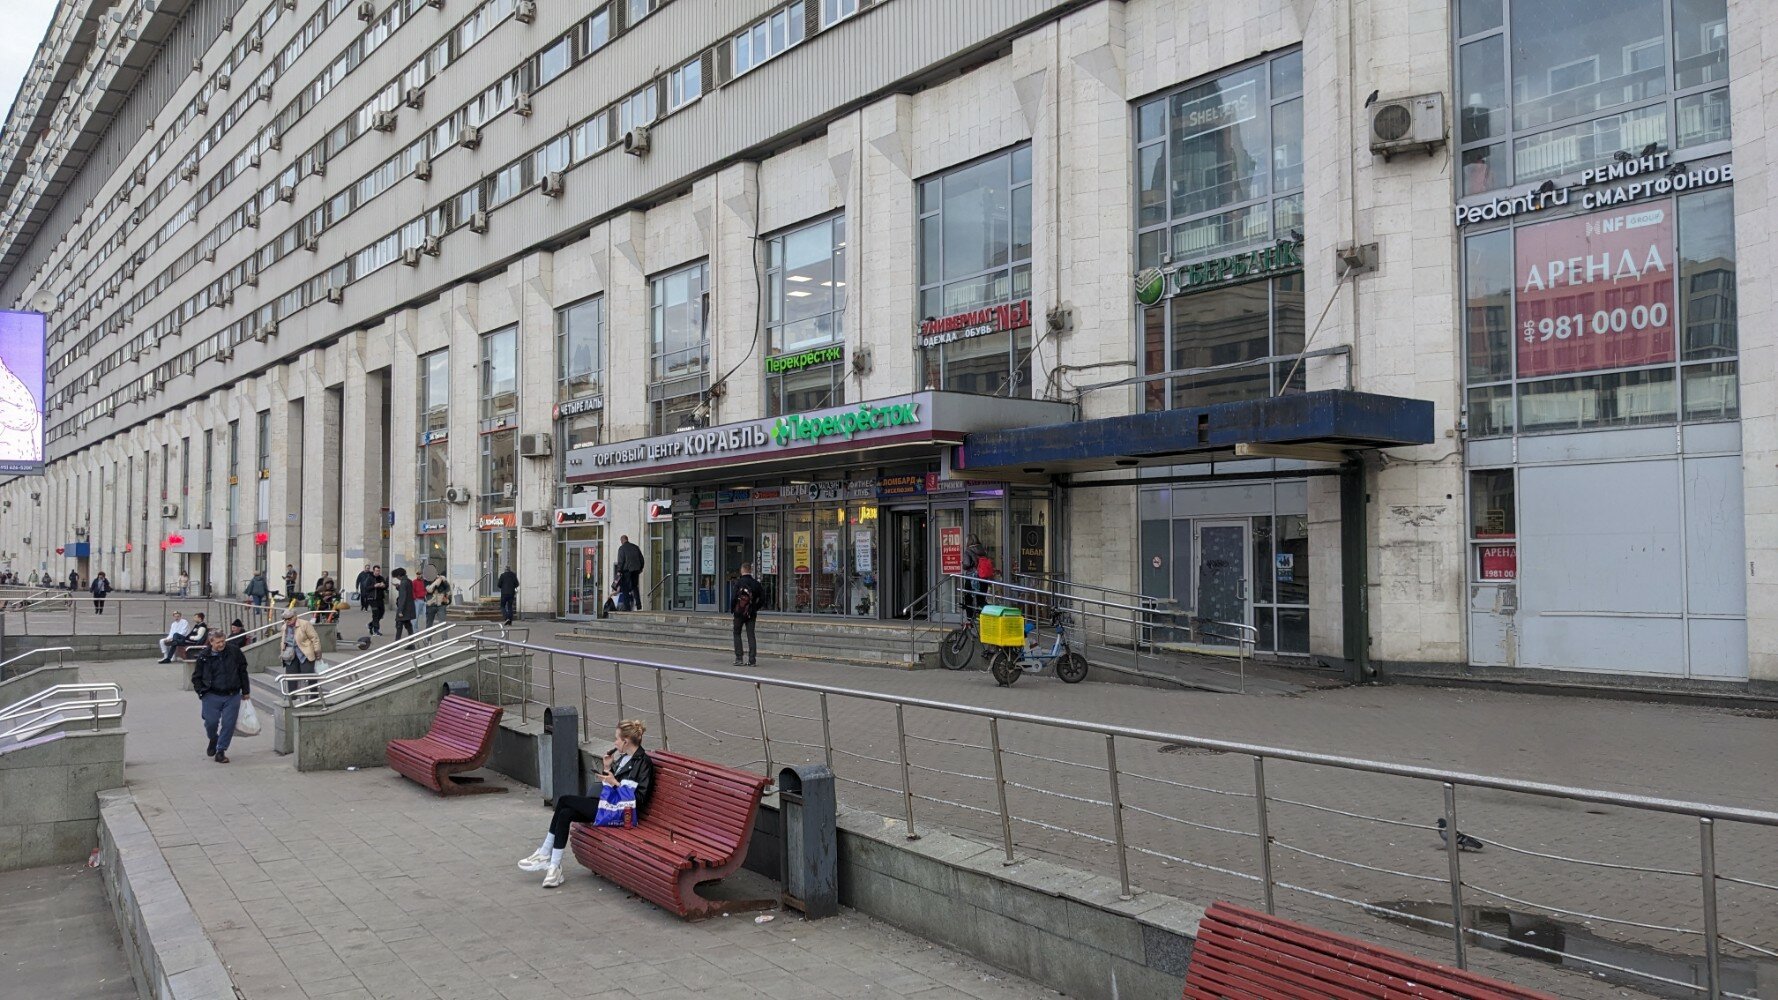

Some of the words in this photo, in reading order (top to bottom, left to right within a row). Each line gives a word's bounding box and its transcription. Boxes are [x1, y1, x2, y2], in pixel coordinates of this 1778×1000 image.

[1189, 94, 1249, 127] SHELTERS
[1581, 152, 1670, 186] РЕМОНТ
[1582, 164, 1734, 210] СМАРТФОНОВ
[1456, 186, 1570, 227] Pedant.ru
[1603, 217, 1624, 234] NF
[1174, 240, 1304, 290] СБЕРБАНК
[1523, 244, 1666, 294] АРЕНДА
[923, 331, 958, 348] ОДЕЖДА
[965, 324, 992, 339] ОБУВЬ
[1539, 313, 1584, 342] 981
[1591, 308, 1627, 335] 00
[1631, 302, 1668, 330] 00
[592, 443, 647, 467] ТОРГОВЫЙ
[648, 440, 681, 462] ЦЕНТР
[684, 423, 768, 456] КОРАБЛЬ
[788, 402, 920, 442] Перекрёсток
[780, 485, 808, 497] ЦВЕТЫ
[883, 476, 916, 486] ЛОМБАРД
[1021, 548, 1043, 556] ТАБАК
[1484, 548, 1516, 558] АРЕНД
